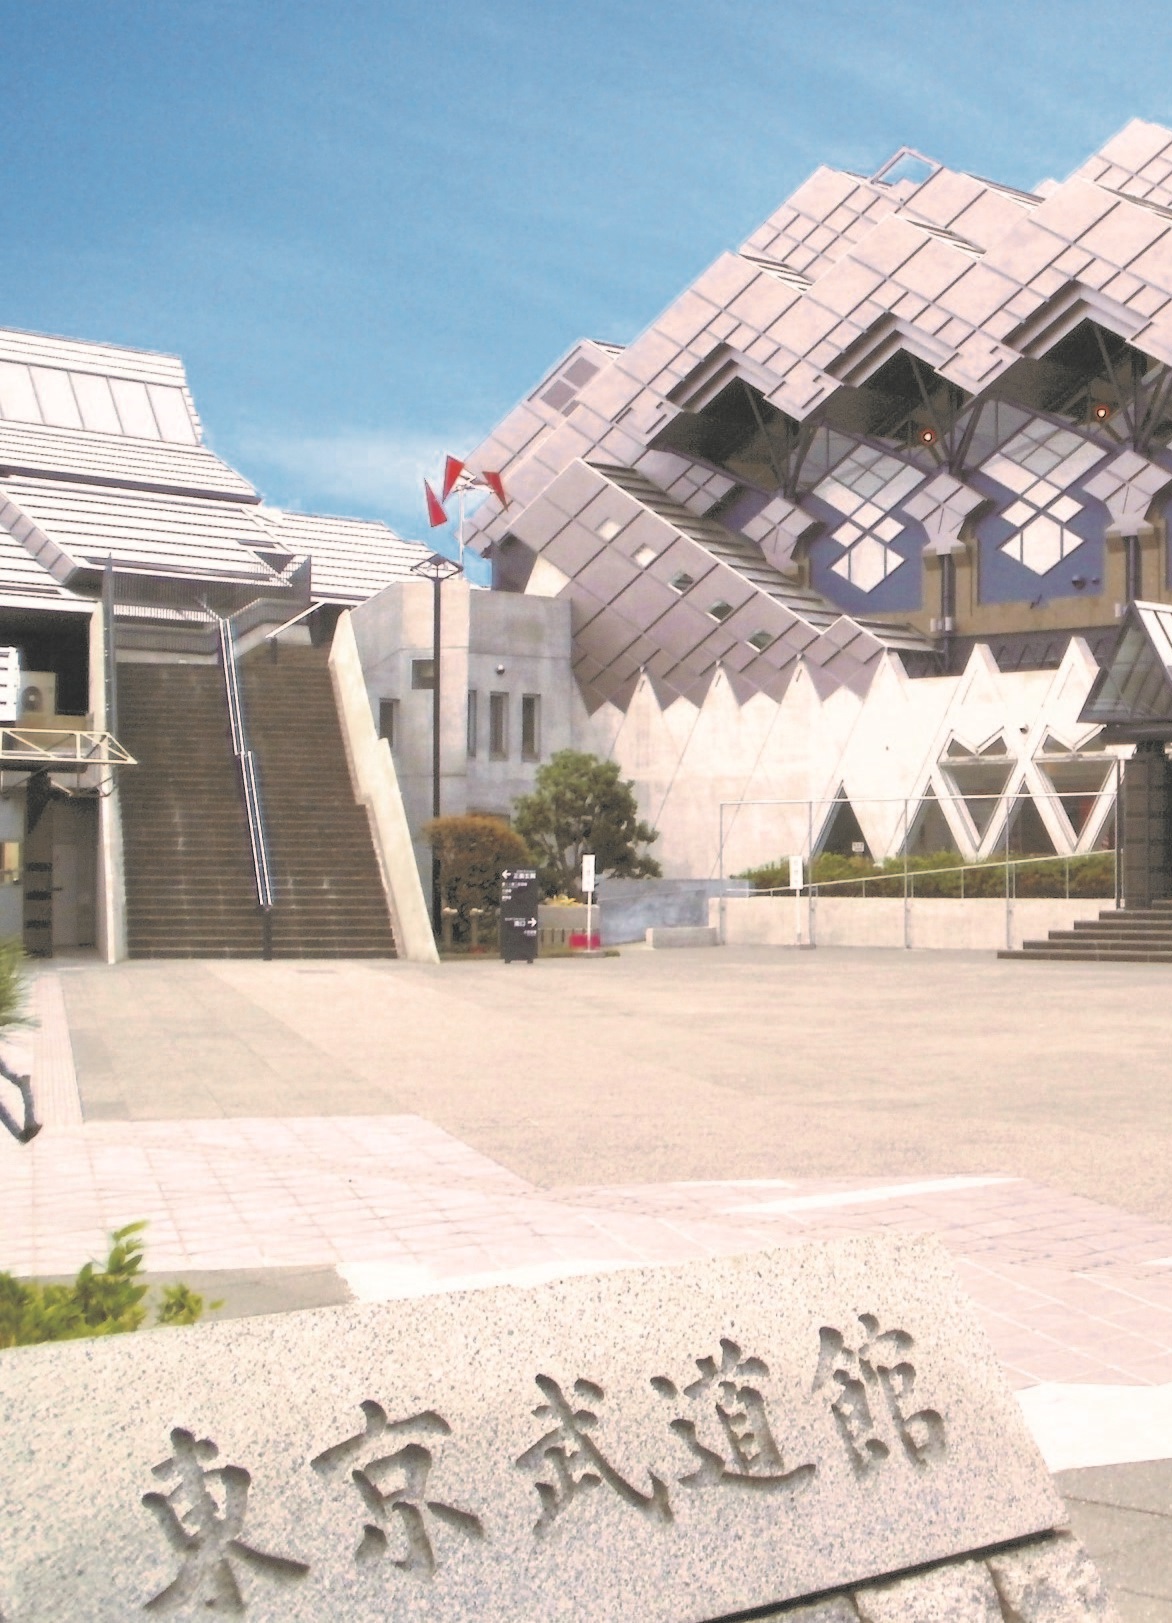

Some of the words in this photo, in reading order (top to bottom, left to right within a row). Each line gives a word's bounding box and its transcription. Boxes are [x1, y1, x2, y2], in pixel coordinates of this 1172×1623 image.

[141, 1312, 947, 1613] 東京武道館
